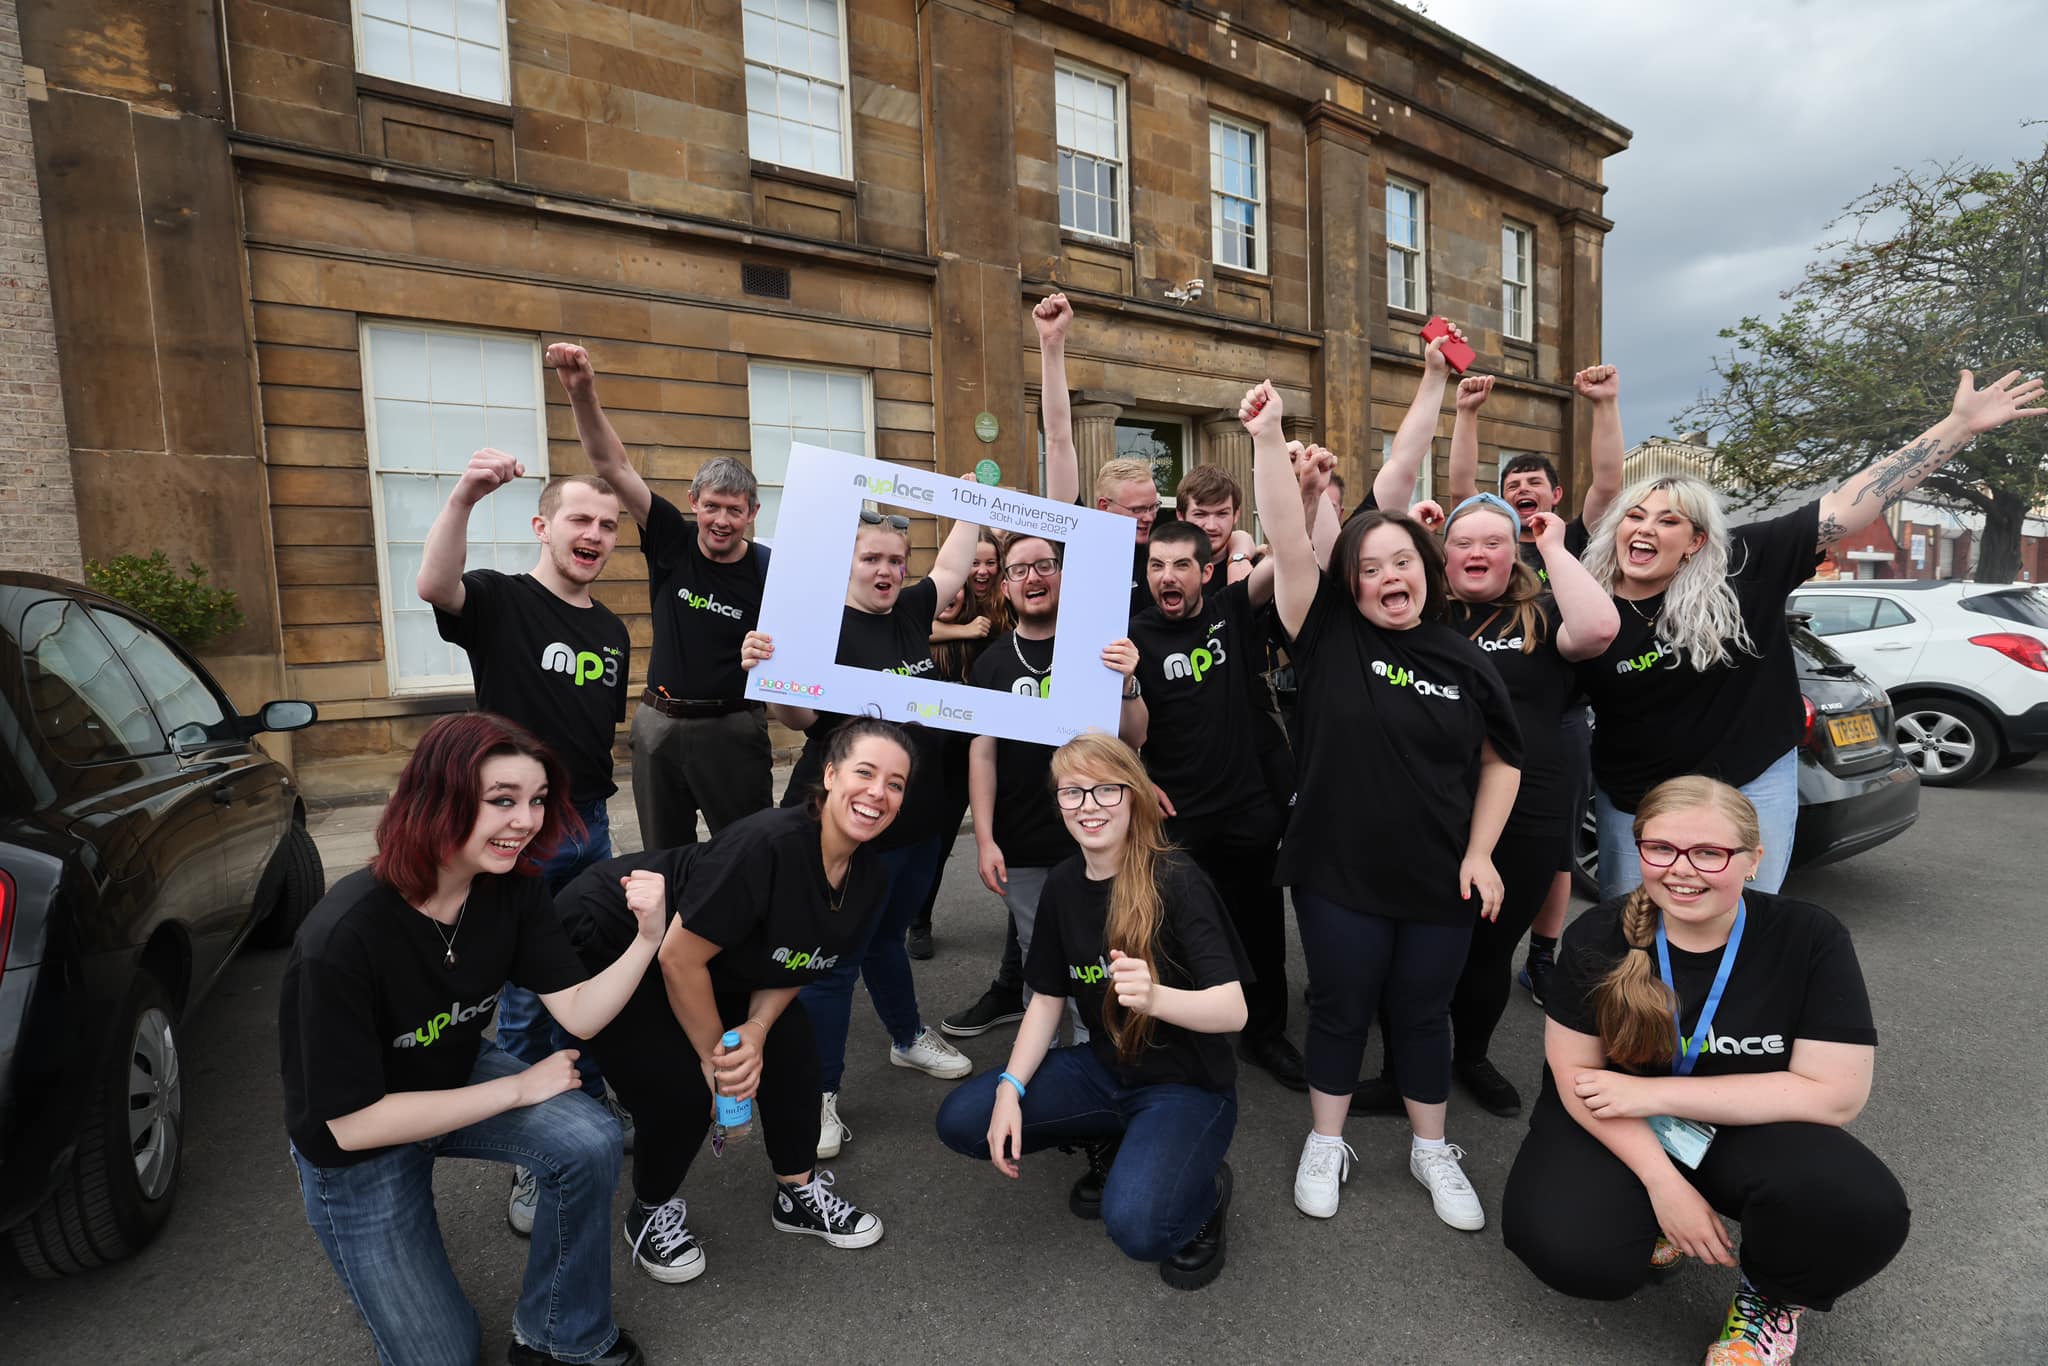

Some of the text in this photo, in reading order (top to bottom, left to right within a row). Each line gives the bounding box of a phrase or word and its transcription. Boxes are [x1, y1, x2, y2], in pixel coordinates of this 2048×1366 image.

[853, 474, 935, 501] myplace
[952, 487, 987, 508] 10th
[991, 497, 1079, 530] Anniversary
[989, 511, 1068, 536] 30th June 2022
[678, 588, 744, 620] myplace
[541, 642, 618, 687] mp3
[1163, 638, 1227, 682] mp3
[906, 699, 974, 721] myplace
